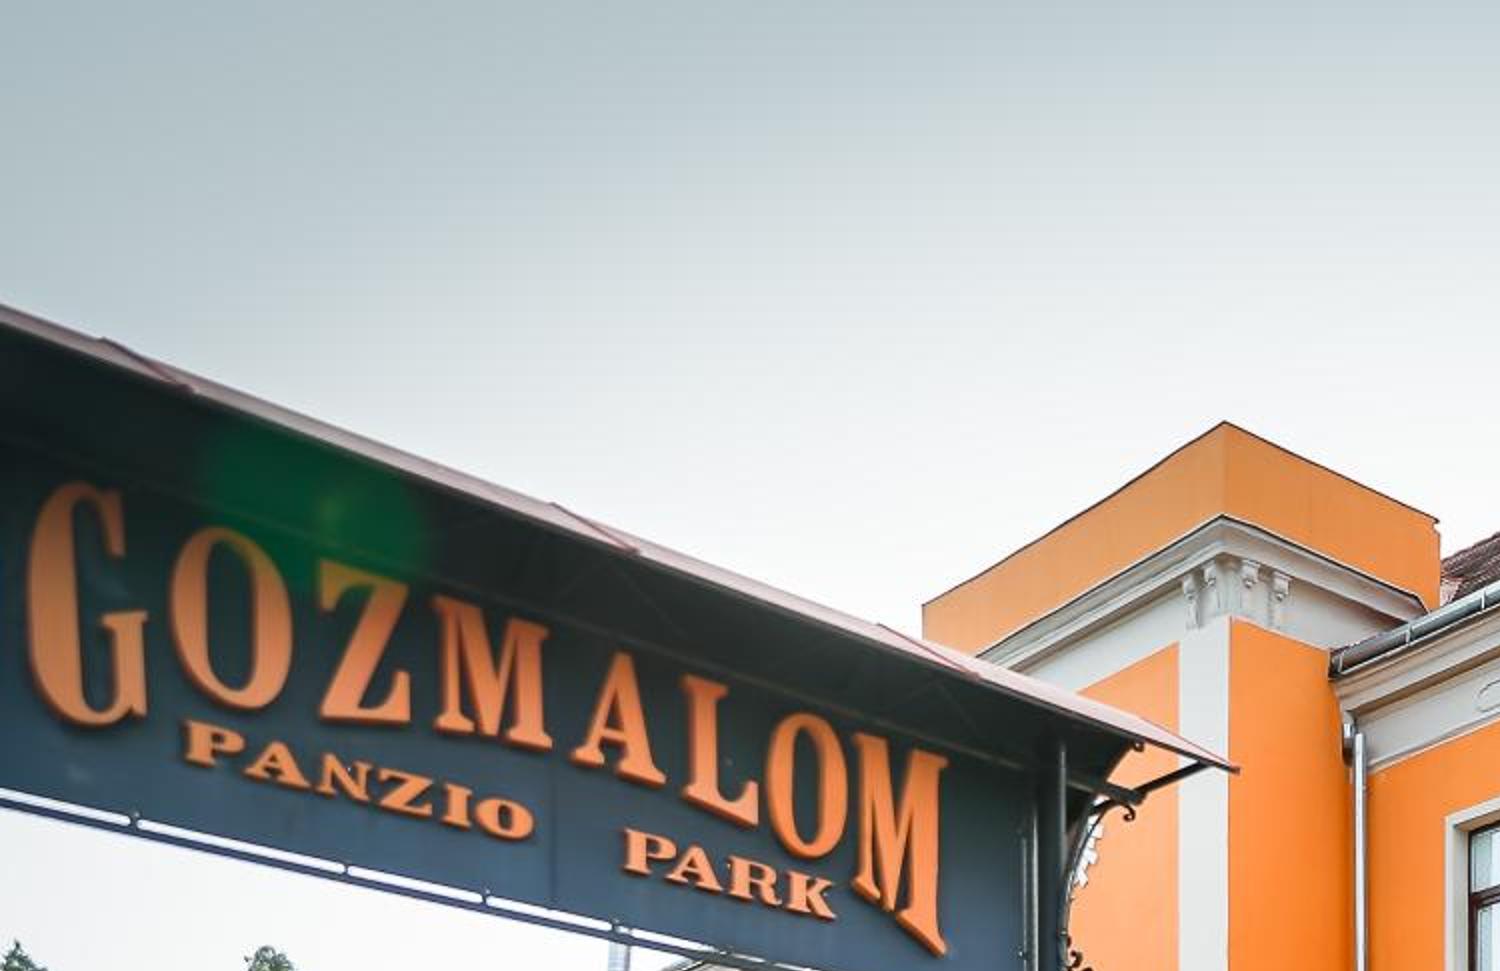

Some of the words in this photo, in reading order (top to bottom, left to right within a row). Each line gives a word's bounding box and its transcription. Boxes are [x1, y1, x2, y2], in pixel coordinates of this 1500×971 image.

[27, 481, 948, 956] GOZMALOM
[184, 720, 535, 840] PANZIO
[621, 828, 836, 919] PARK
